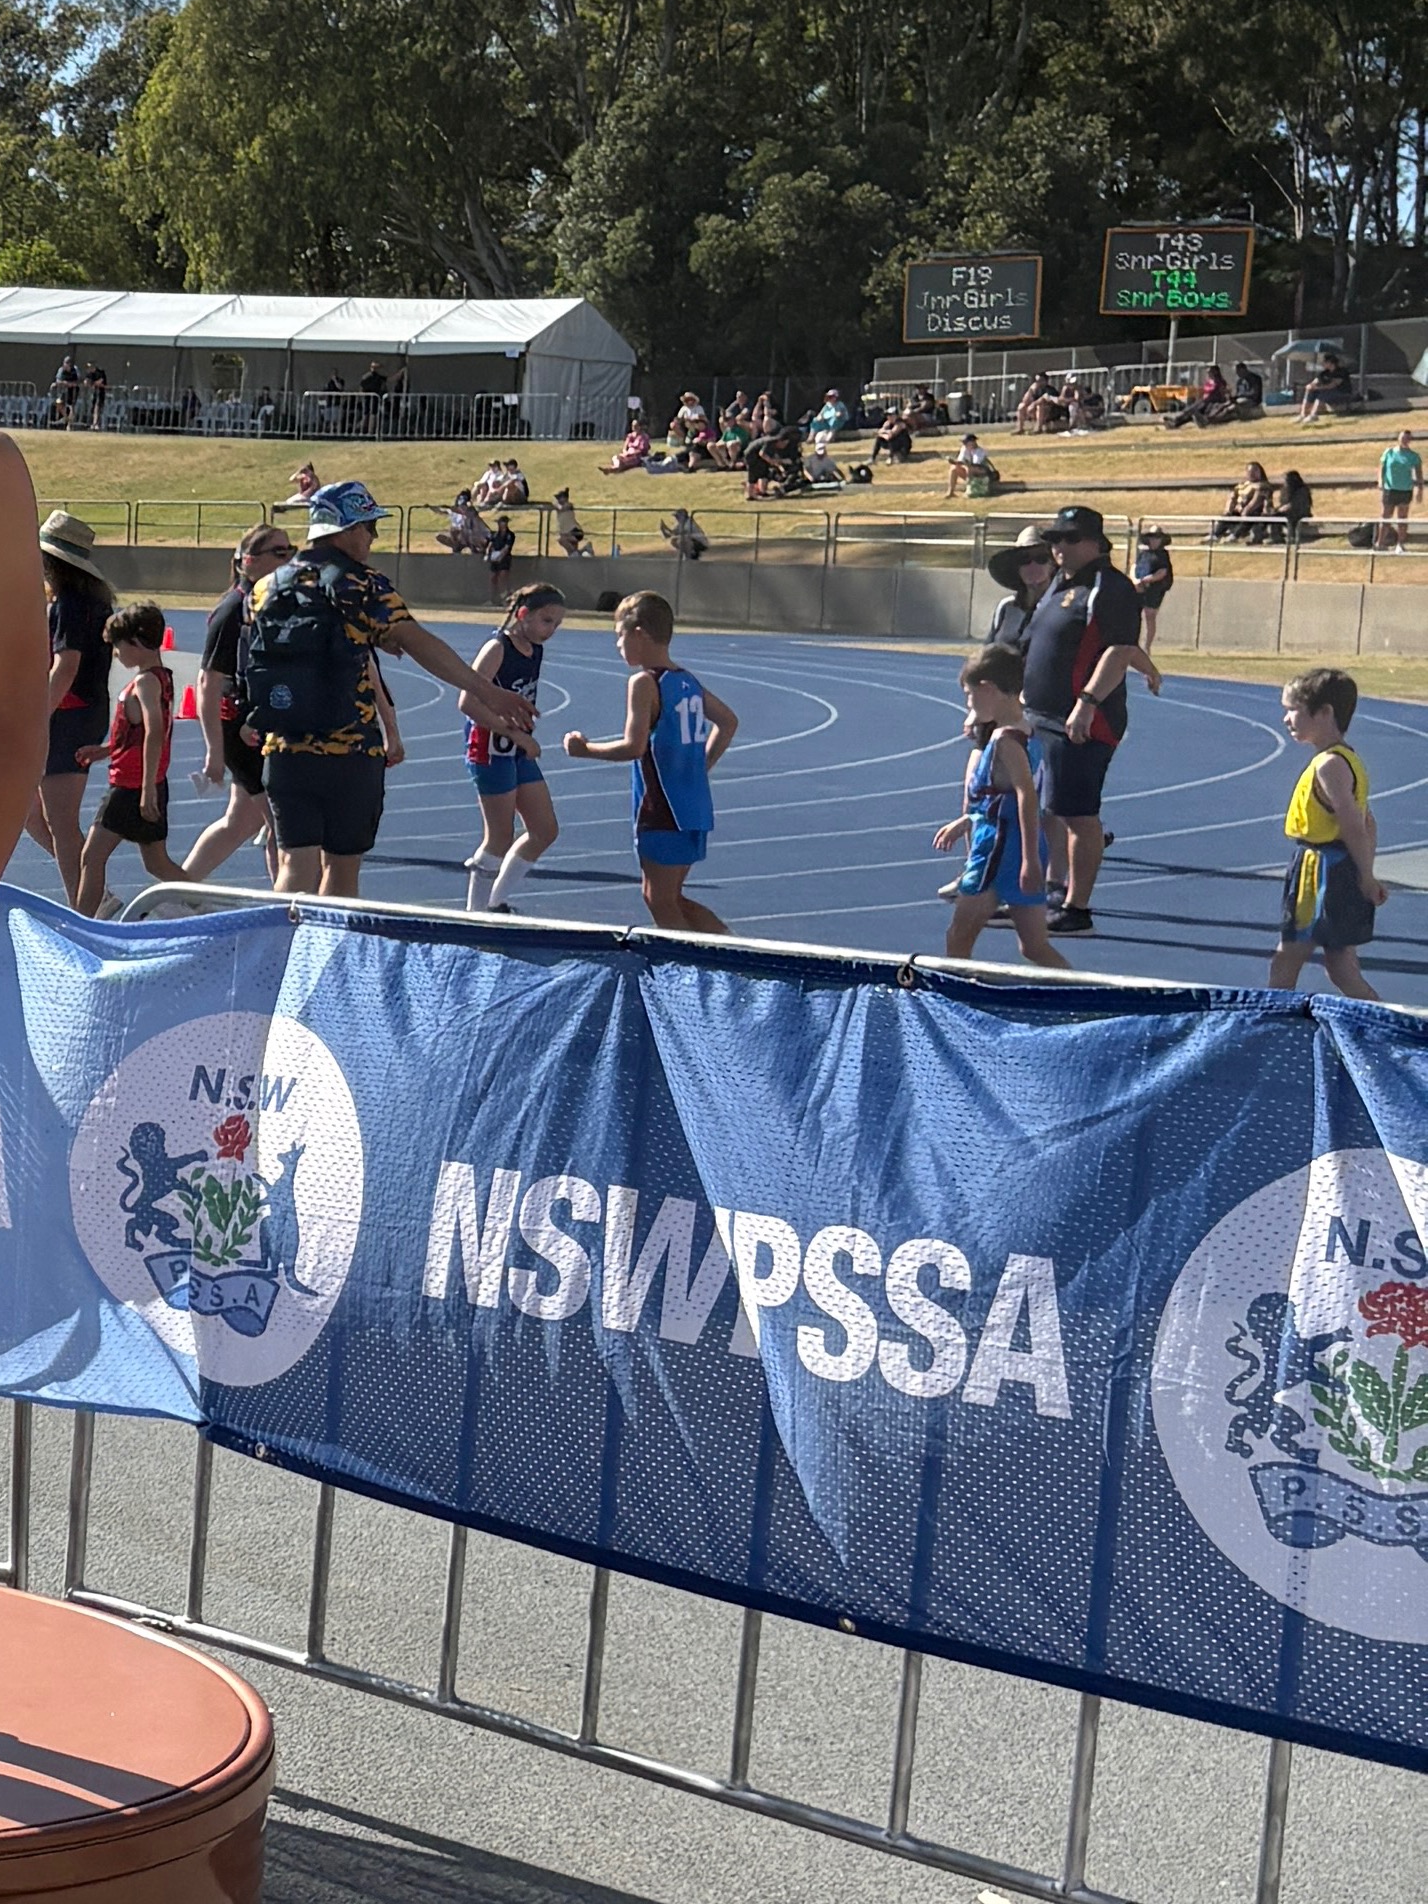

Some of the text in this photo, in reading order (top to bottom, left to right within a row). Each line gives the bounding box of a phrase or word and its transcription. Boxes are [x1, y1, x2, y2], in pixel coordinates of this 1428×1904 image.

[1151, 270, 1197, 289] T44
[927, 313, 1012, 332] Discus
[675, 694, 707, 745] 12
[422, 1160, 1073, 1421] NSWPSSA
